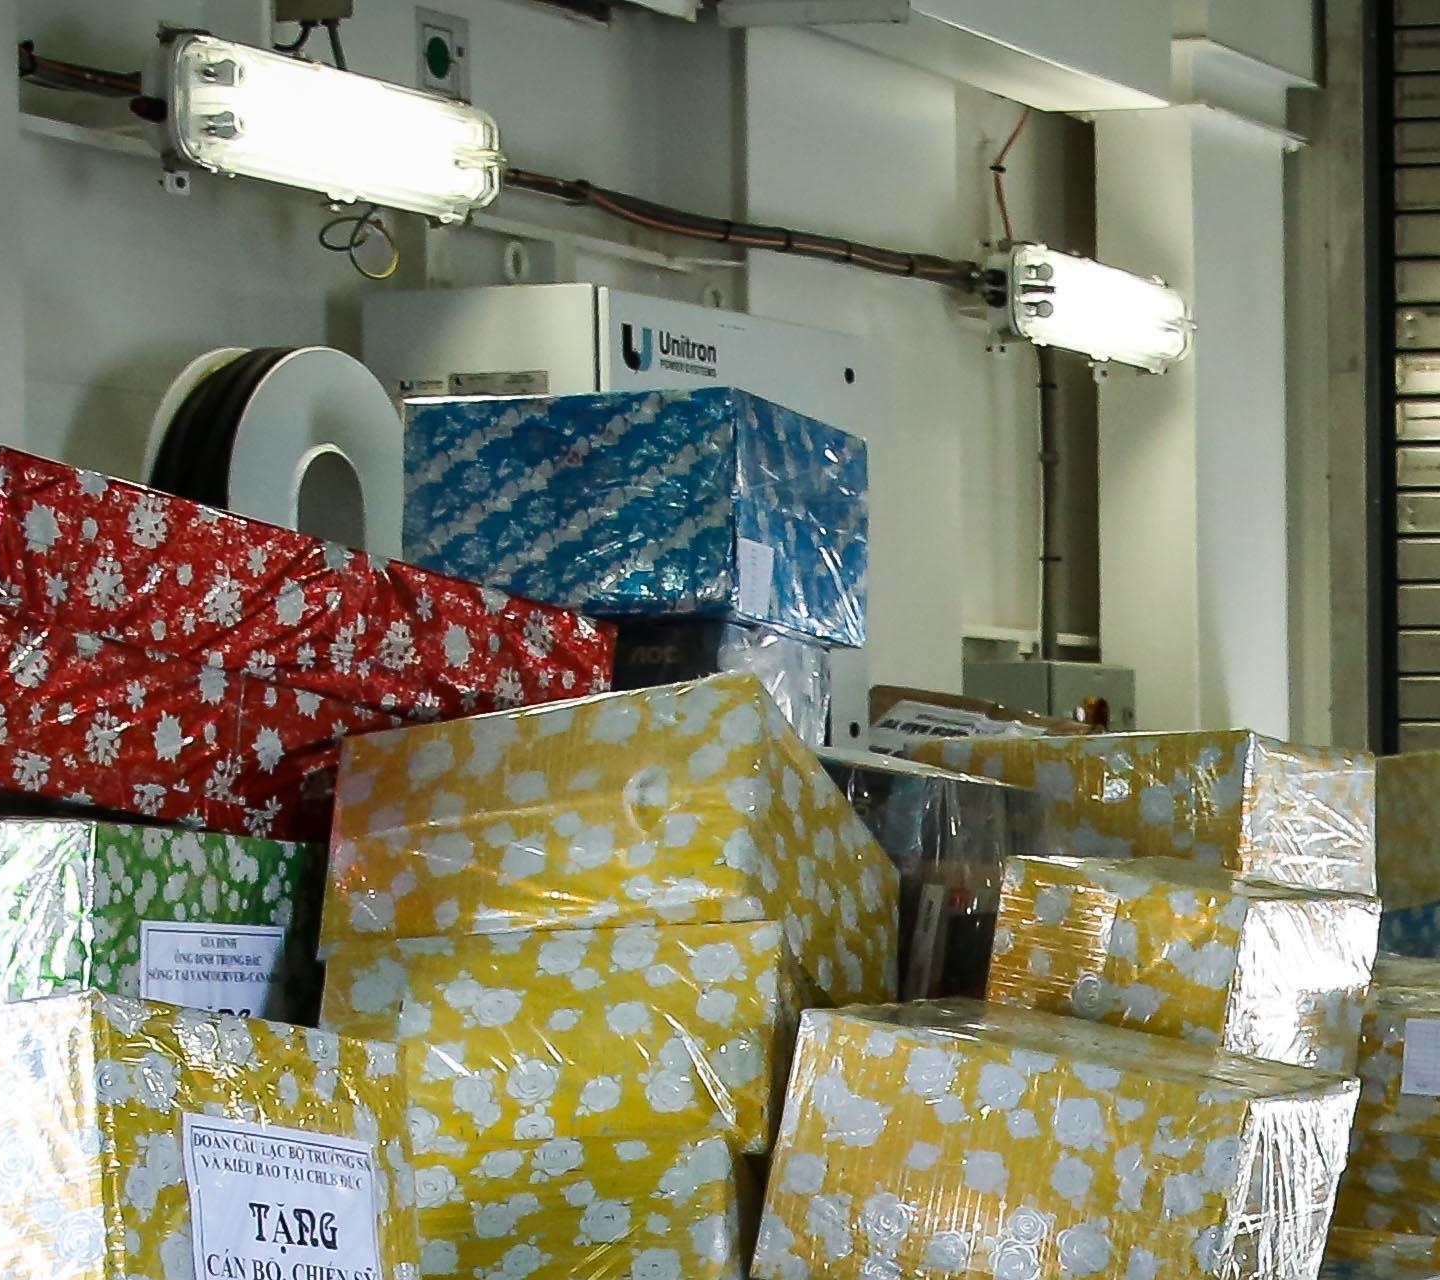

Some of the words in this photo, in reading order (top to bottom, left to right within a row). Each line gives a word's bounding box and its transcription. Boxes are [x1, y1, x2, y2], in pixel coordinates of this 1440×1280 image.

[659, 330, 717, 363] Unitron
[200, 1154, 221, 1172] VÀ
[284, 1166, 305, 1184] TẠI
[248, 1200, 339, 1254] TẶNG
[207, 1249, 248, 1280] CÁN
